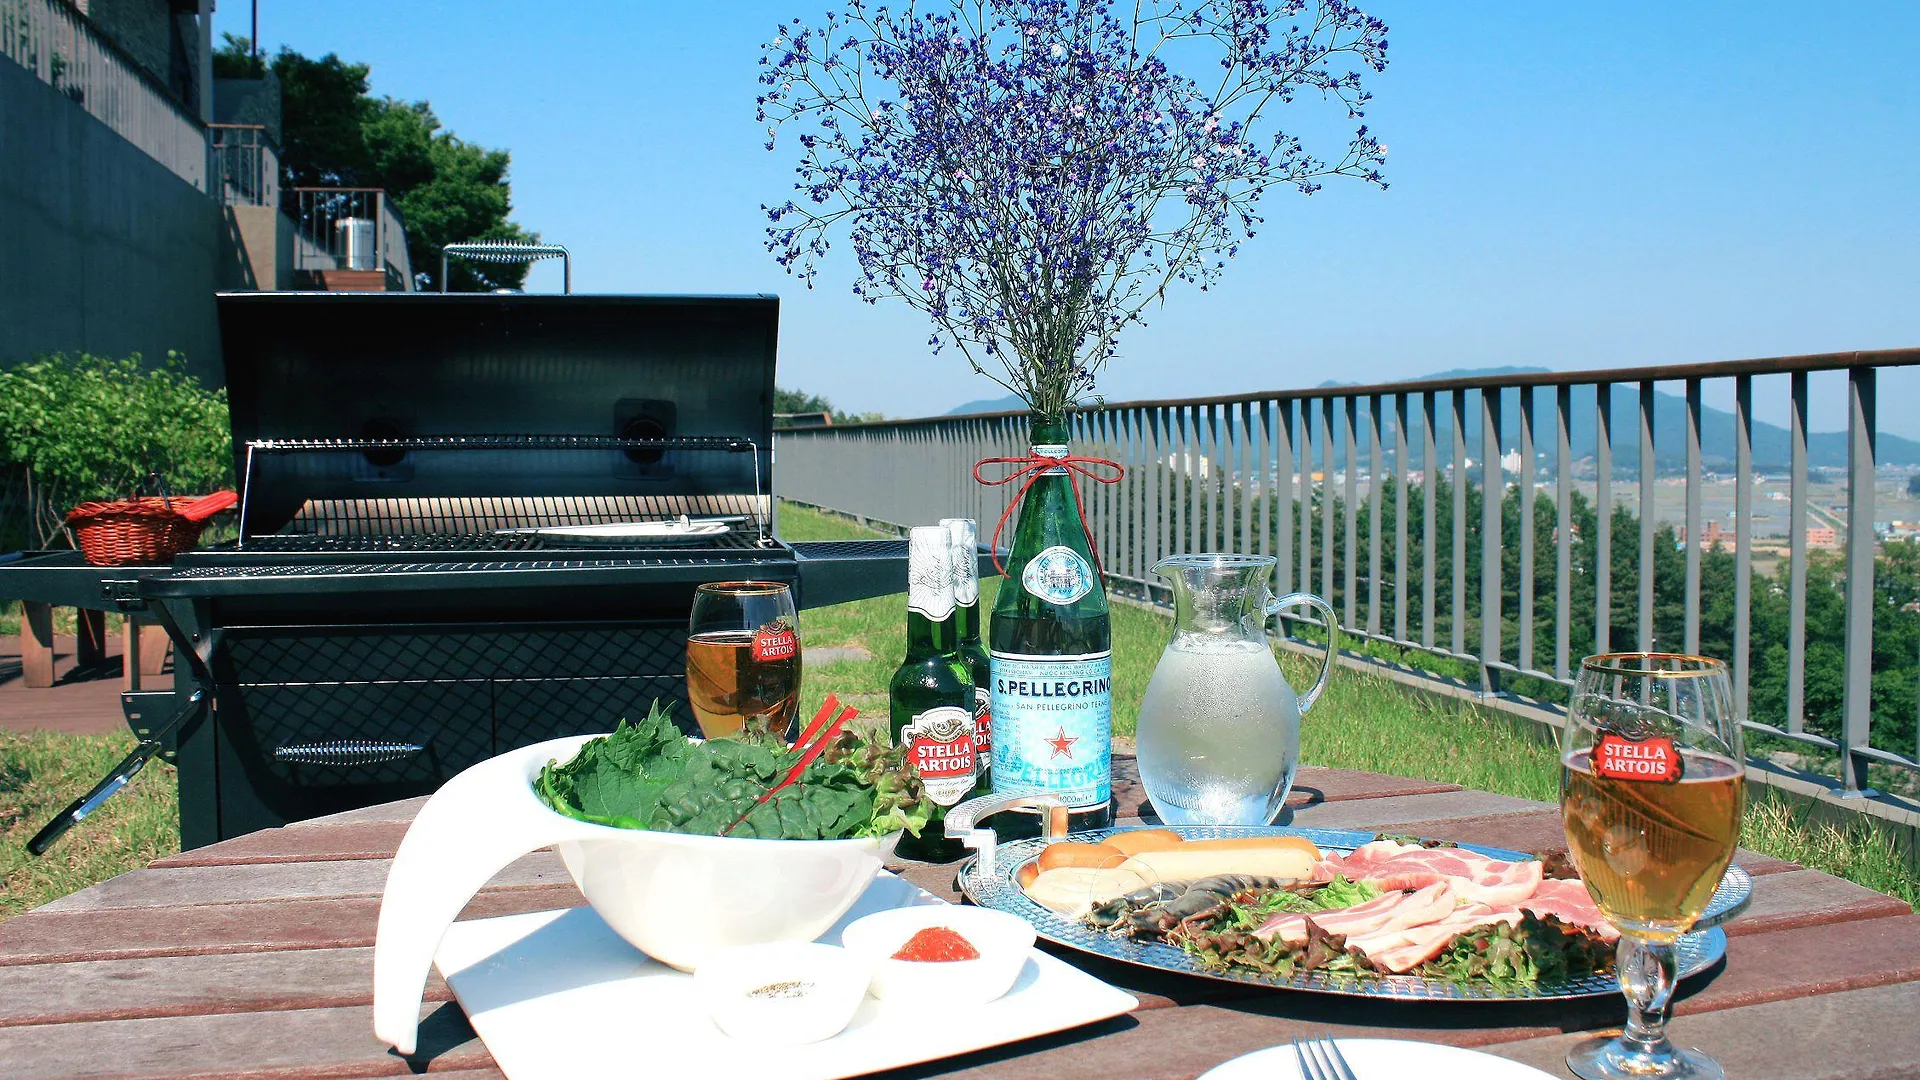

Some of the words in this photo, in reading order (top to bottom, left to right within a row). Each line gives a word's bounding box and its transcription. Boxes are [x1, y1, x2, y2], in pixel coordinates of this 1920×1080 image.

[760, 635, 792, 647] STELLA
[761, 645, 793, 657] ARTOIS
[997, 677, 1111, 697] S.PELLEGRINO
[1016, 703, 1033, 711] SAN
[1037, 702, 1089, 711] PELLEGRINO
[917, 742, 970, 758] STELLA
[1604, 743, 1667, 760] STELLA
[917, 756, 970, 772] ARTOIS
[1603, 758, 1667, 775] ARTOIS
